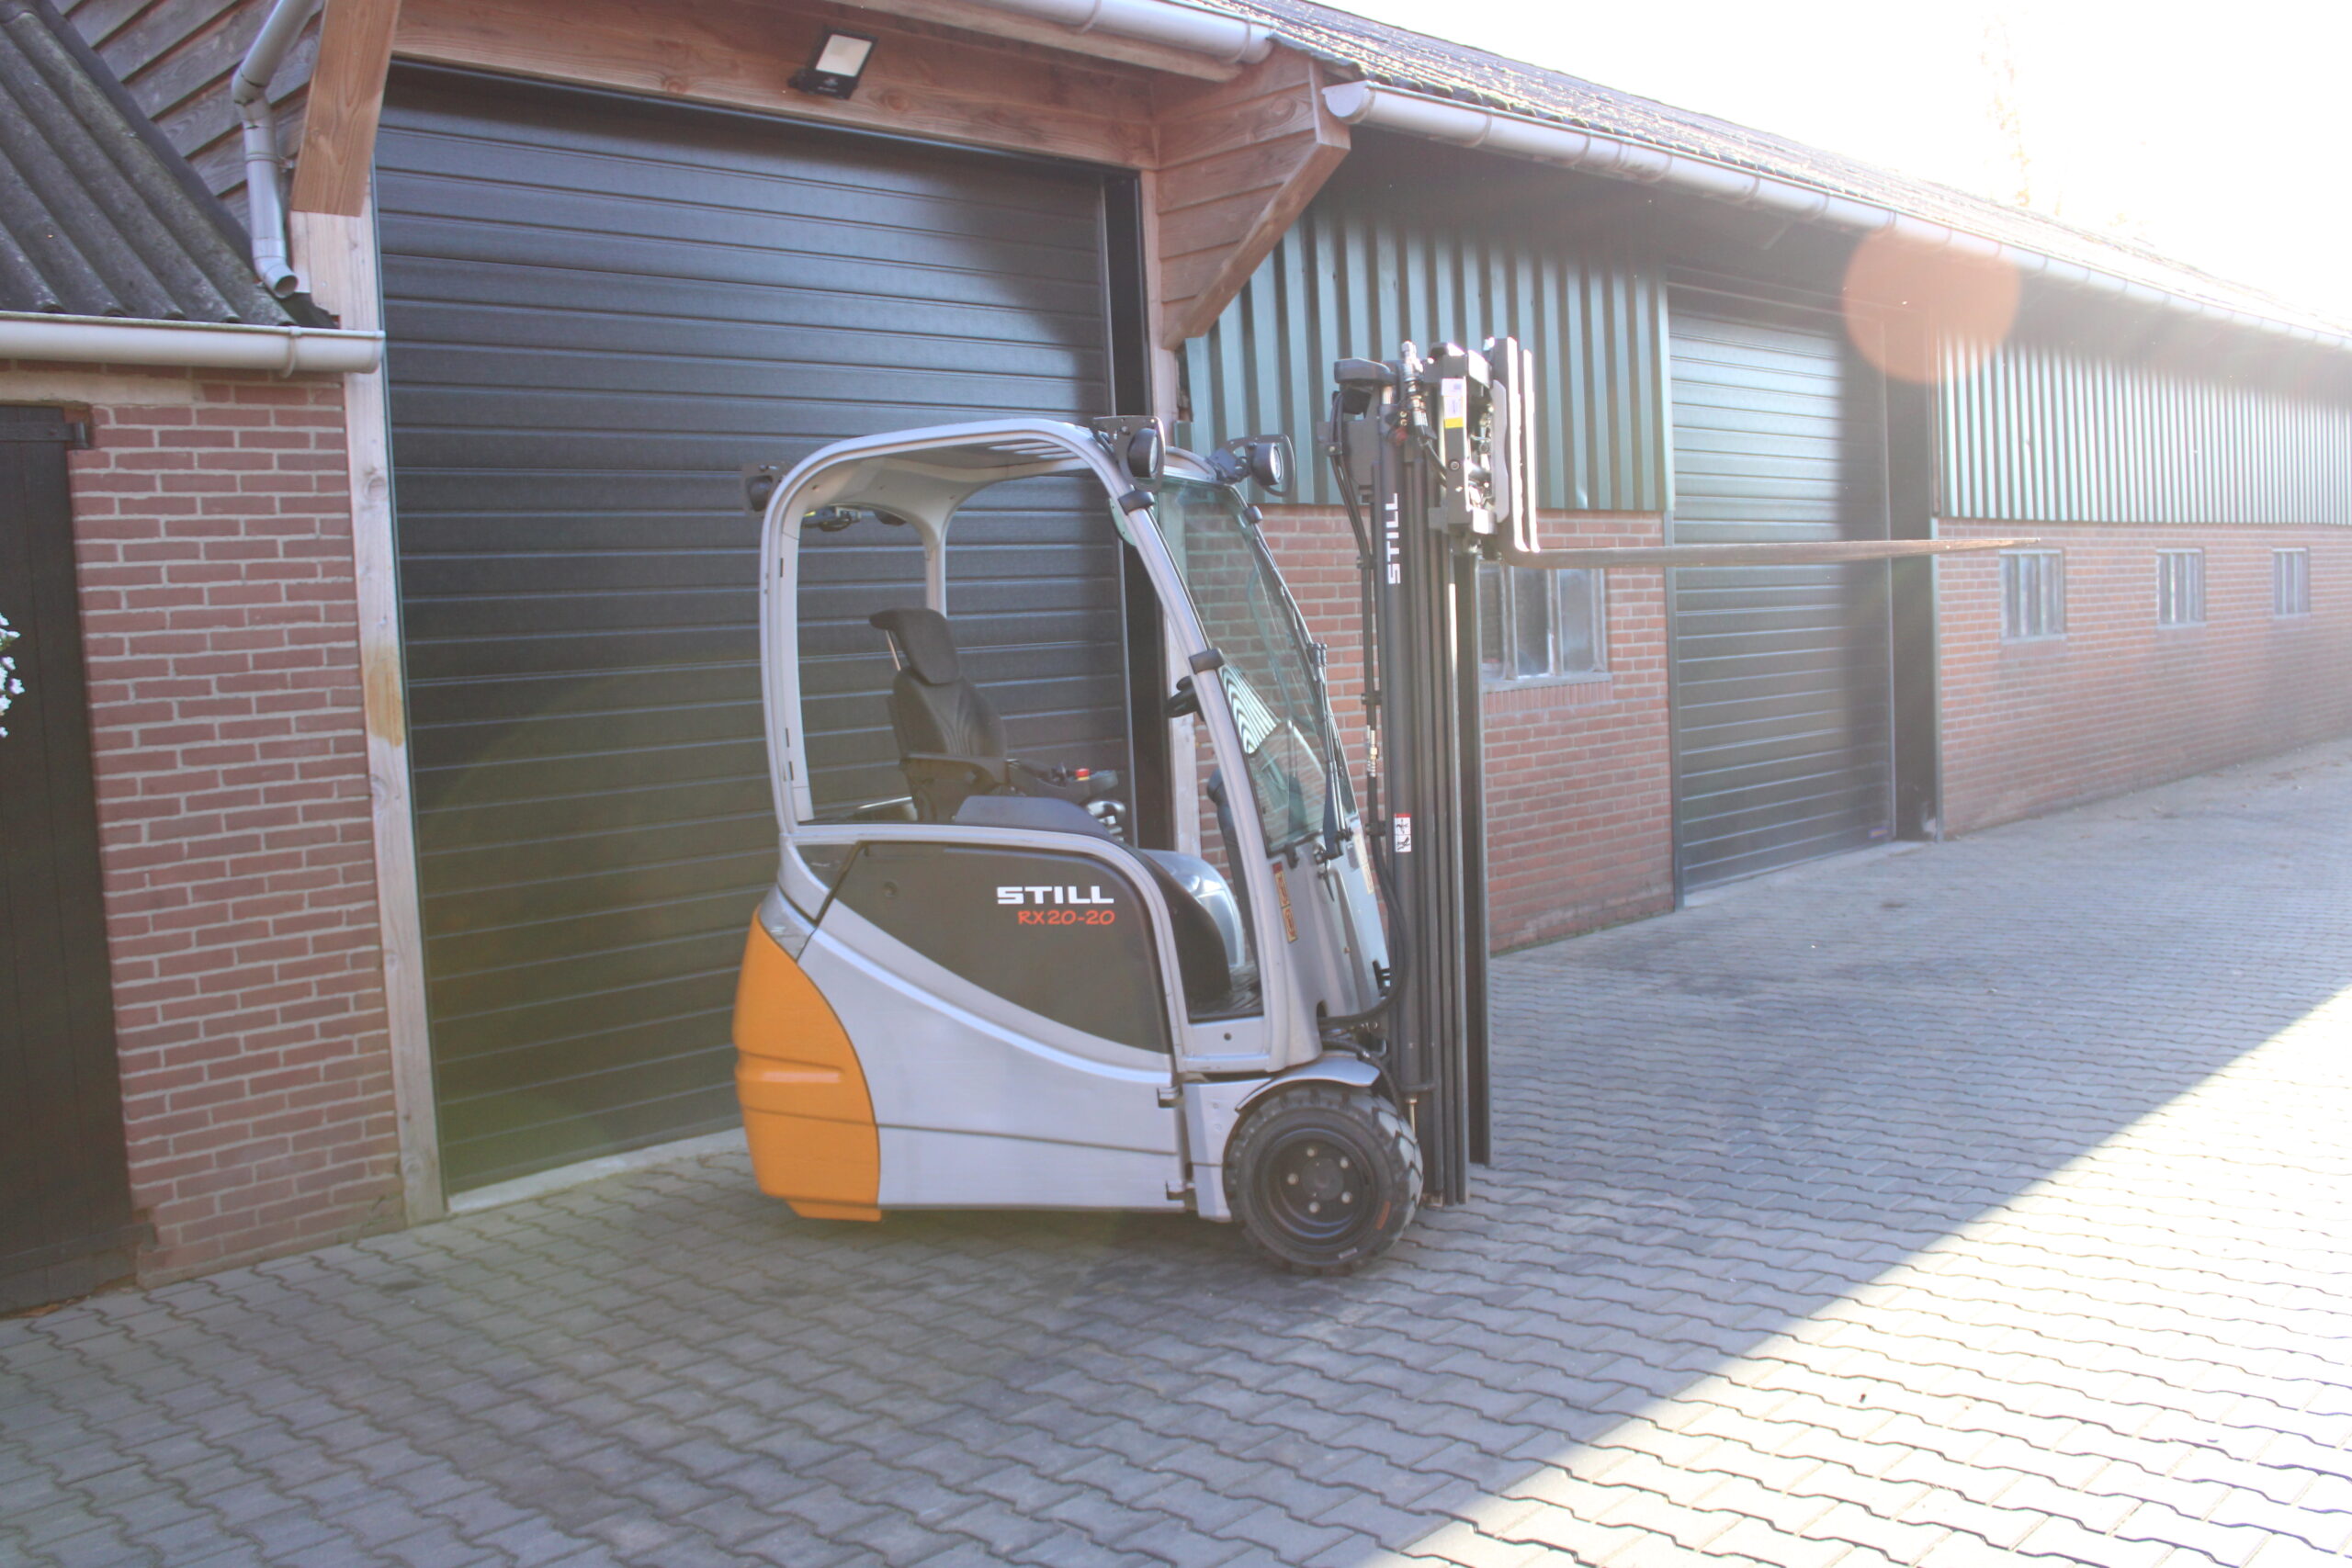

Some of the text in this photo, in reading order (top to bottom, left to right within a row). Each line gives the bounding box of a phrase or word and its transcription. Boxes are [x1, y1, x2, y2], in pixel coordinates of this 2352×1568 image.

[1385, 492, 1401, 584] STILL
[997, 886, 1114, 904] STILL
[1017, 909, 1115, 925] RX20-20
